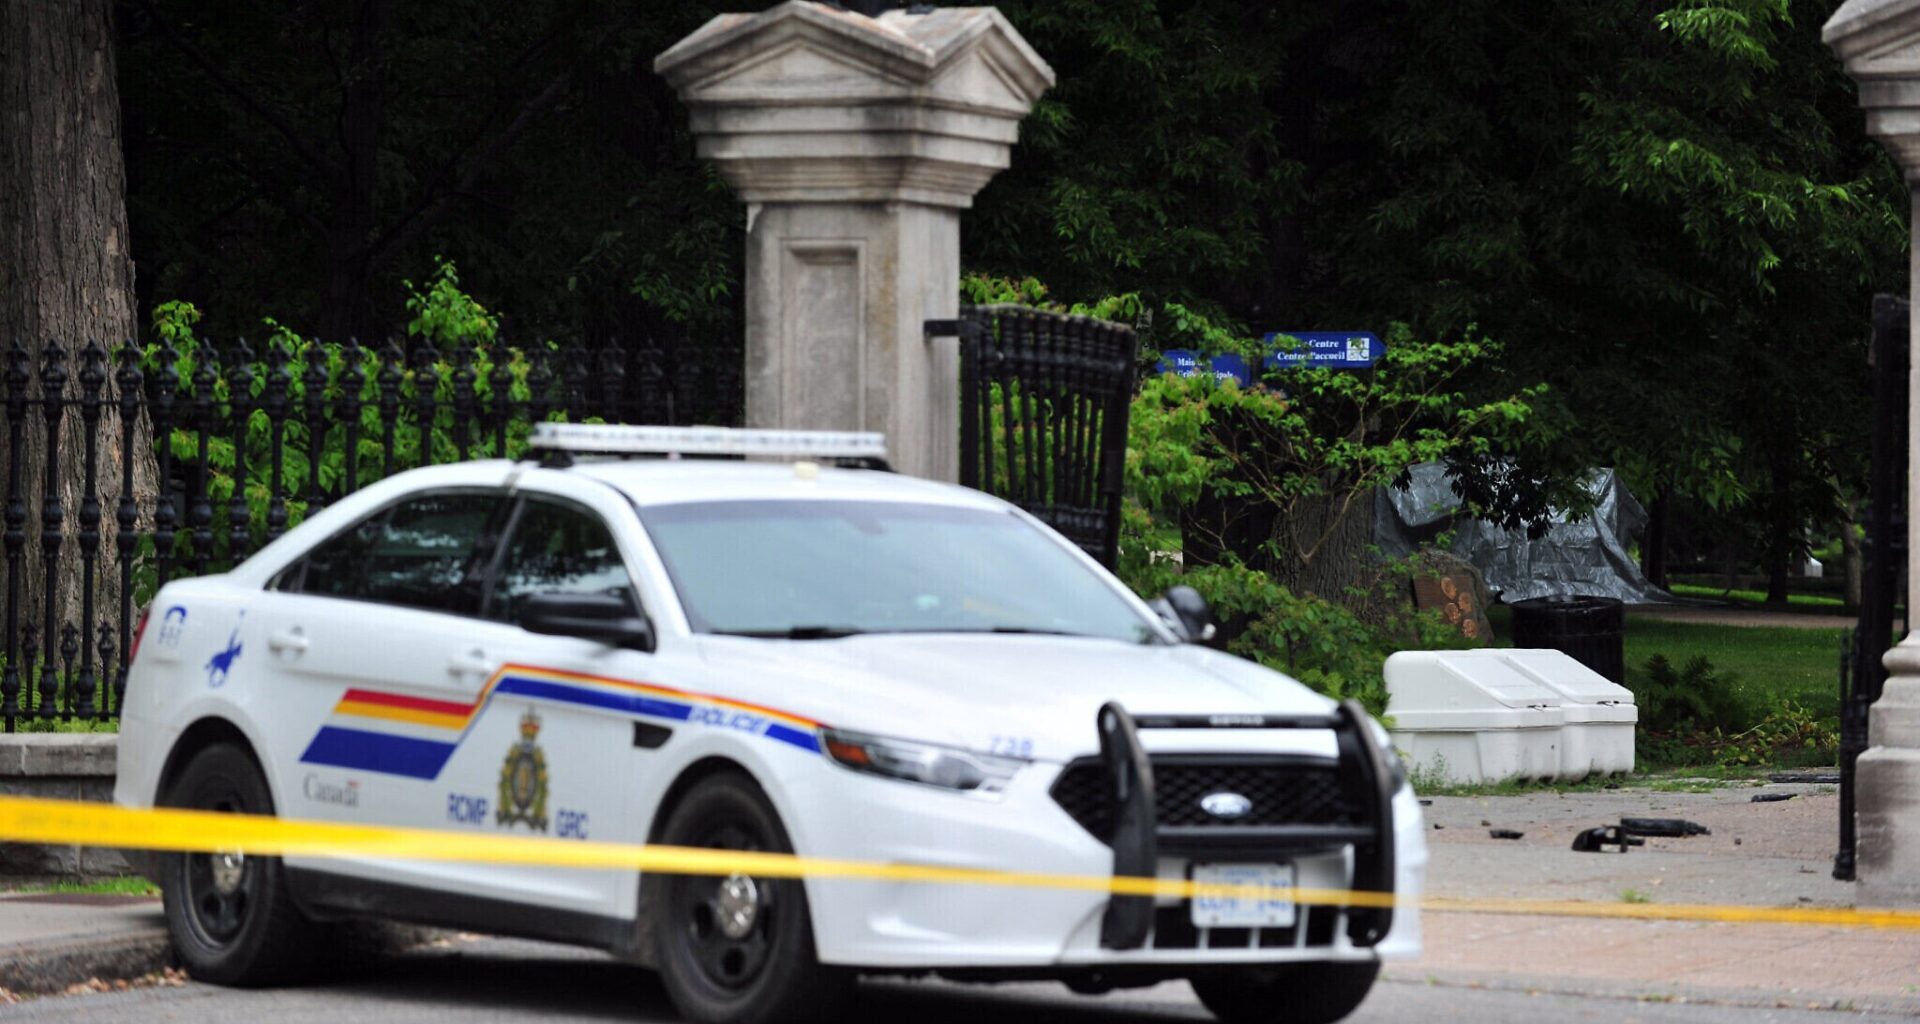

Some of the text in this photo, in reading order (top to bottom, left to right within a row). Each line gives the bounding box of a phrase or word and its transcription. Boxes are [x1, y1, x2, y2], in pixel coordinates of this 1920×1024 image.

[1309, 339, 1340, 348] Centre
[1277, 352, 1306, 361] Centre
[693, 707, 766, 732] POLICE
[303, 772, 359, 807] Canada
[447, 792, 589, 840] RCMP GRC
